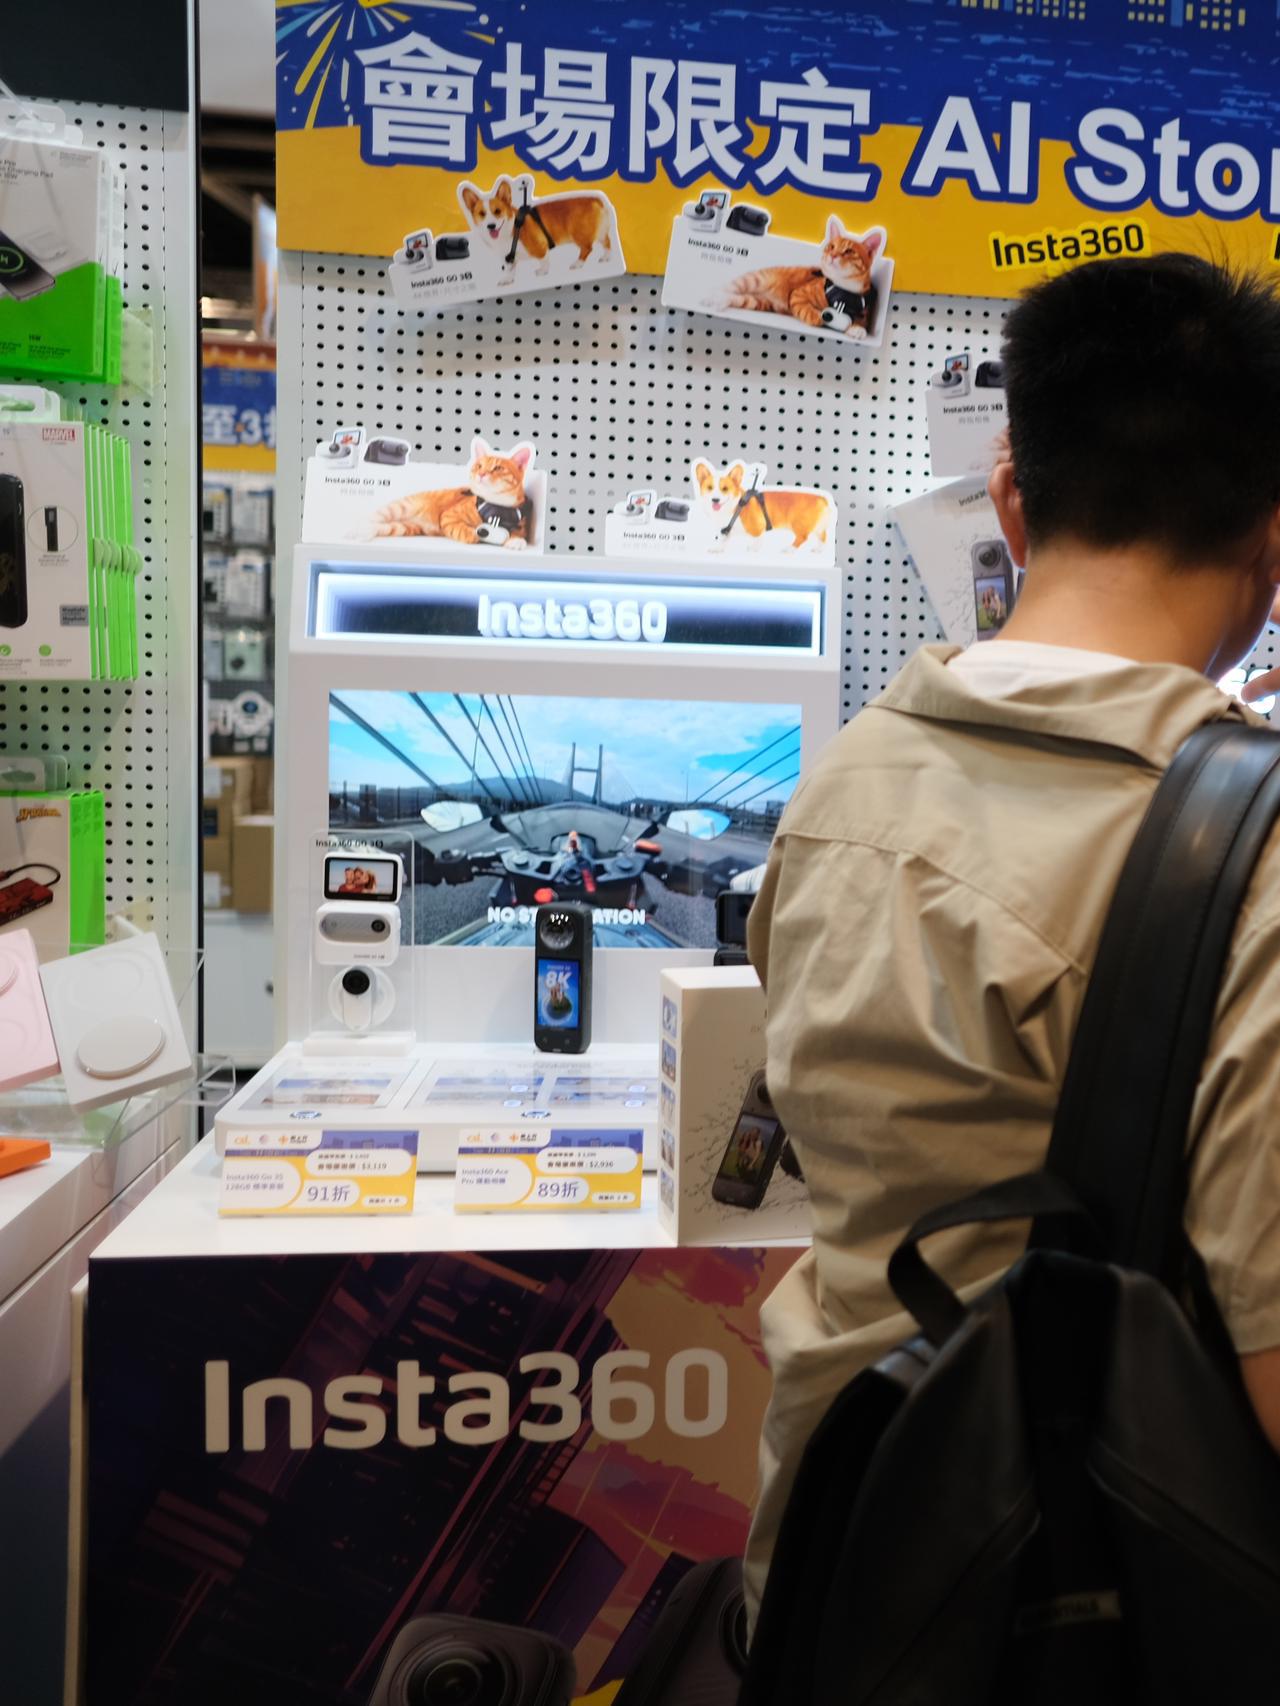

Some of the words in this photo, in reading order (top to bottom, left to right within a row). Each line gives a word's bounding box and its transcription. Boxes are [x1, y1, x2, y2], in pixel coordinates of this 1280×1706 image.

[355, 31, 871, 192] 會場限定
[911, 96, 1032, 195] AI
[992, 224, 1145, 267] Insta360
[42, 428, 75, 440] MARVEL
[478, 594, 668, 643] Insta360
[487, 907, 515, 923] NO
[545, 971, 573, 990] 8K
[307, 1184, 350, 1203] 91折
[537, 1181, 581, 1199] 89折
[205, 1347, 729, 1454] Insta360
